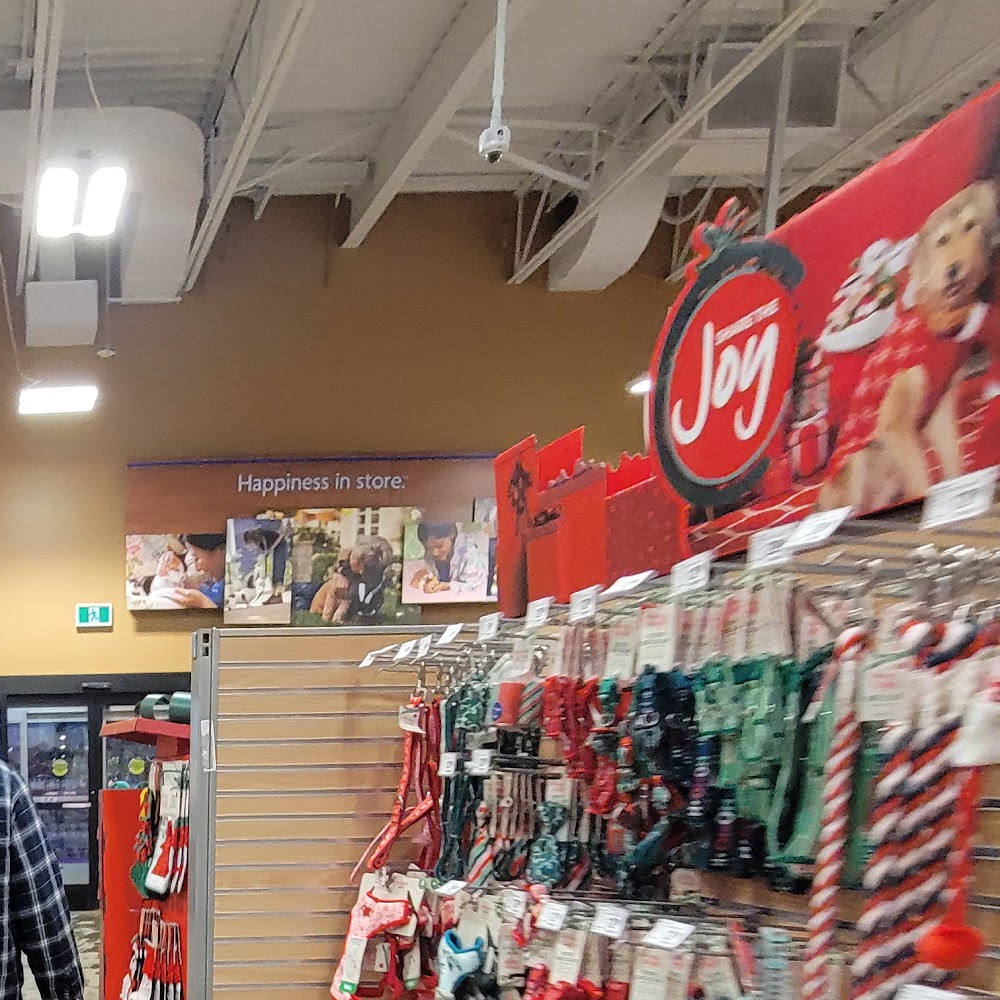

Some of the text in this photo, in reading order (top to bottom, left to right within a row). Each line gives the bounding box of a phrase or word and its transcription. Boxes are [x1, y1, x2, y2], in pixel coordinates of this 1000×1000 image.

[671, 321, 780, 446] Joy
[236, 472, 330, 497] Happiness
[335, 472, 351, 490] in
